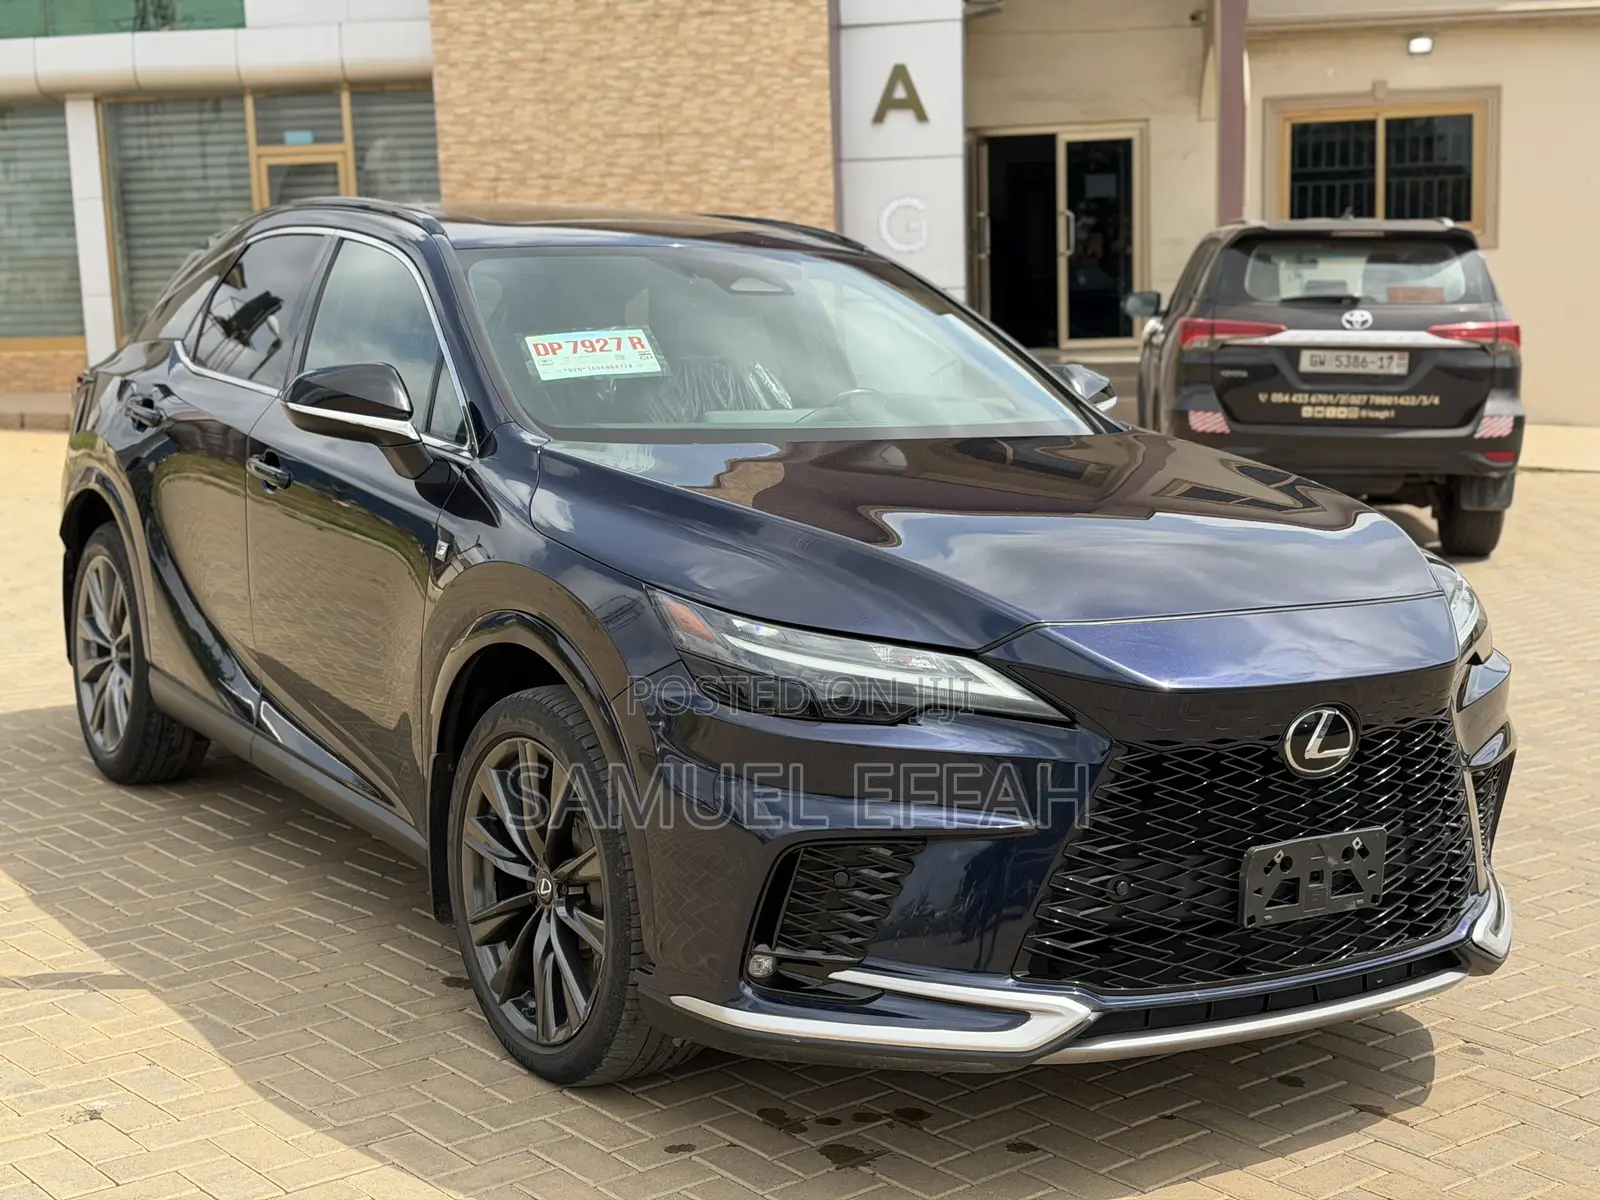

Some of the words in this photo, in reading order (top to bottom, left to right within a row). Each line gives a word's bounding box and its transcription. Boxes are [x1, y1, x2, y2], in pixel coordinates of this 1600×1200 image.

[872, 63, 929, 123] A
[878, 196, 928, 253] G
[532, 341, 563, 357] DP
[565, 336, 622, 355] 7927
[628, 336, 647, 351] R
[1309, 354, 1326, 368] GW
[1335, 354, 1394, 370] 5386-17
